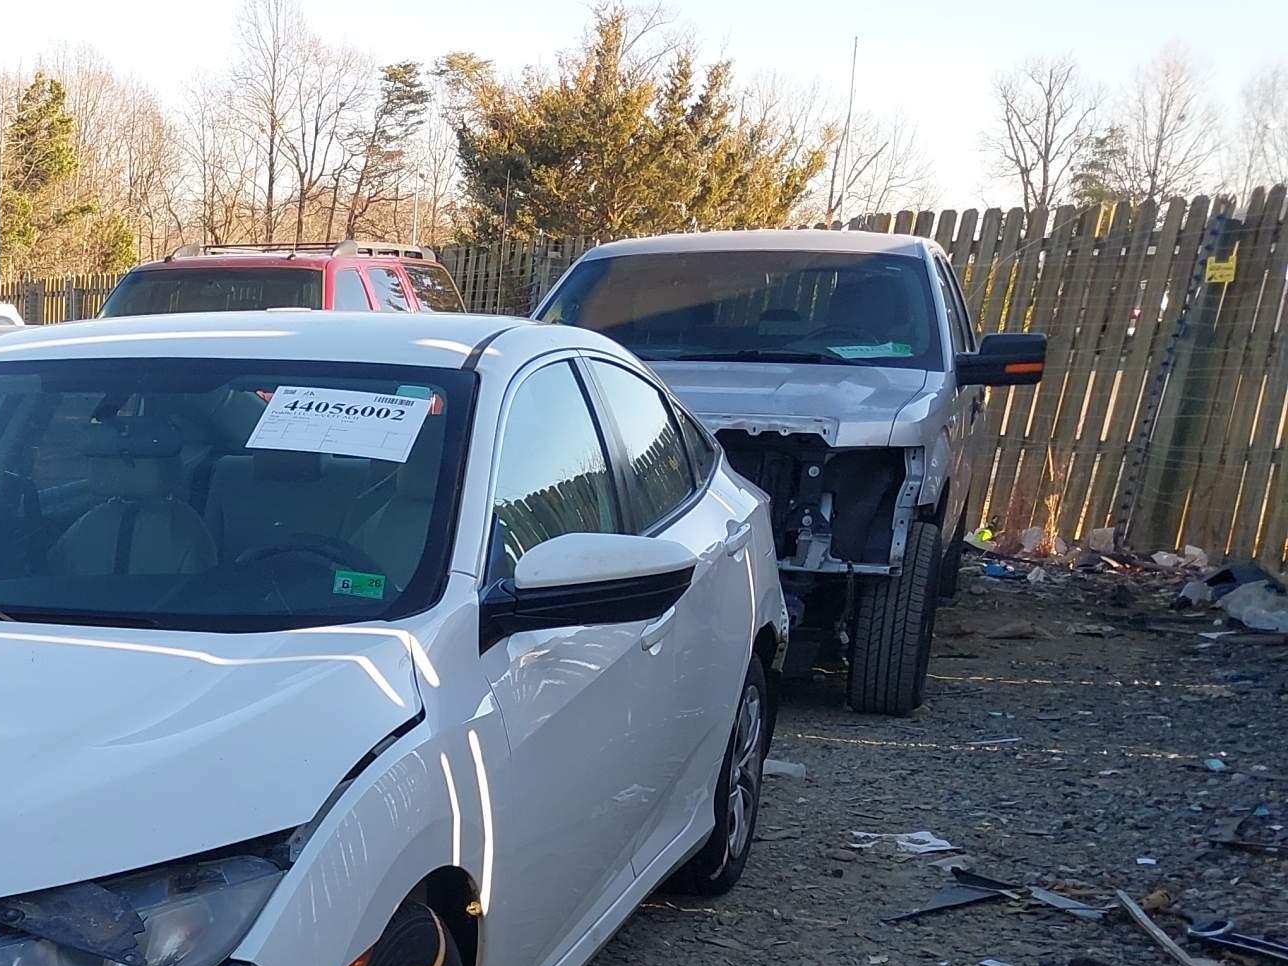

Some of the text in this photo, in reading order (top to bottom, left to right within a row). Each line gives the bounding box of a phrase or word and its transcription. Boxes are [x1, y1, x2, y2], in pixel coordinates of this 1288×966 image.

[284, 399, 406, 421] 44056002
[342, 578, 382, 589] 6 26
